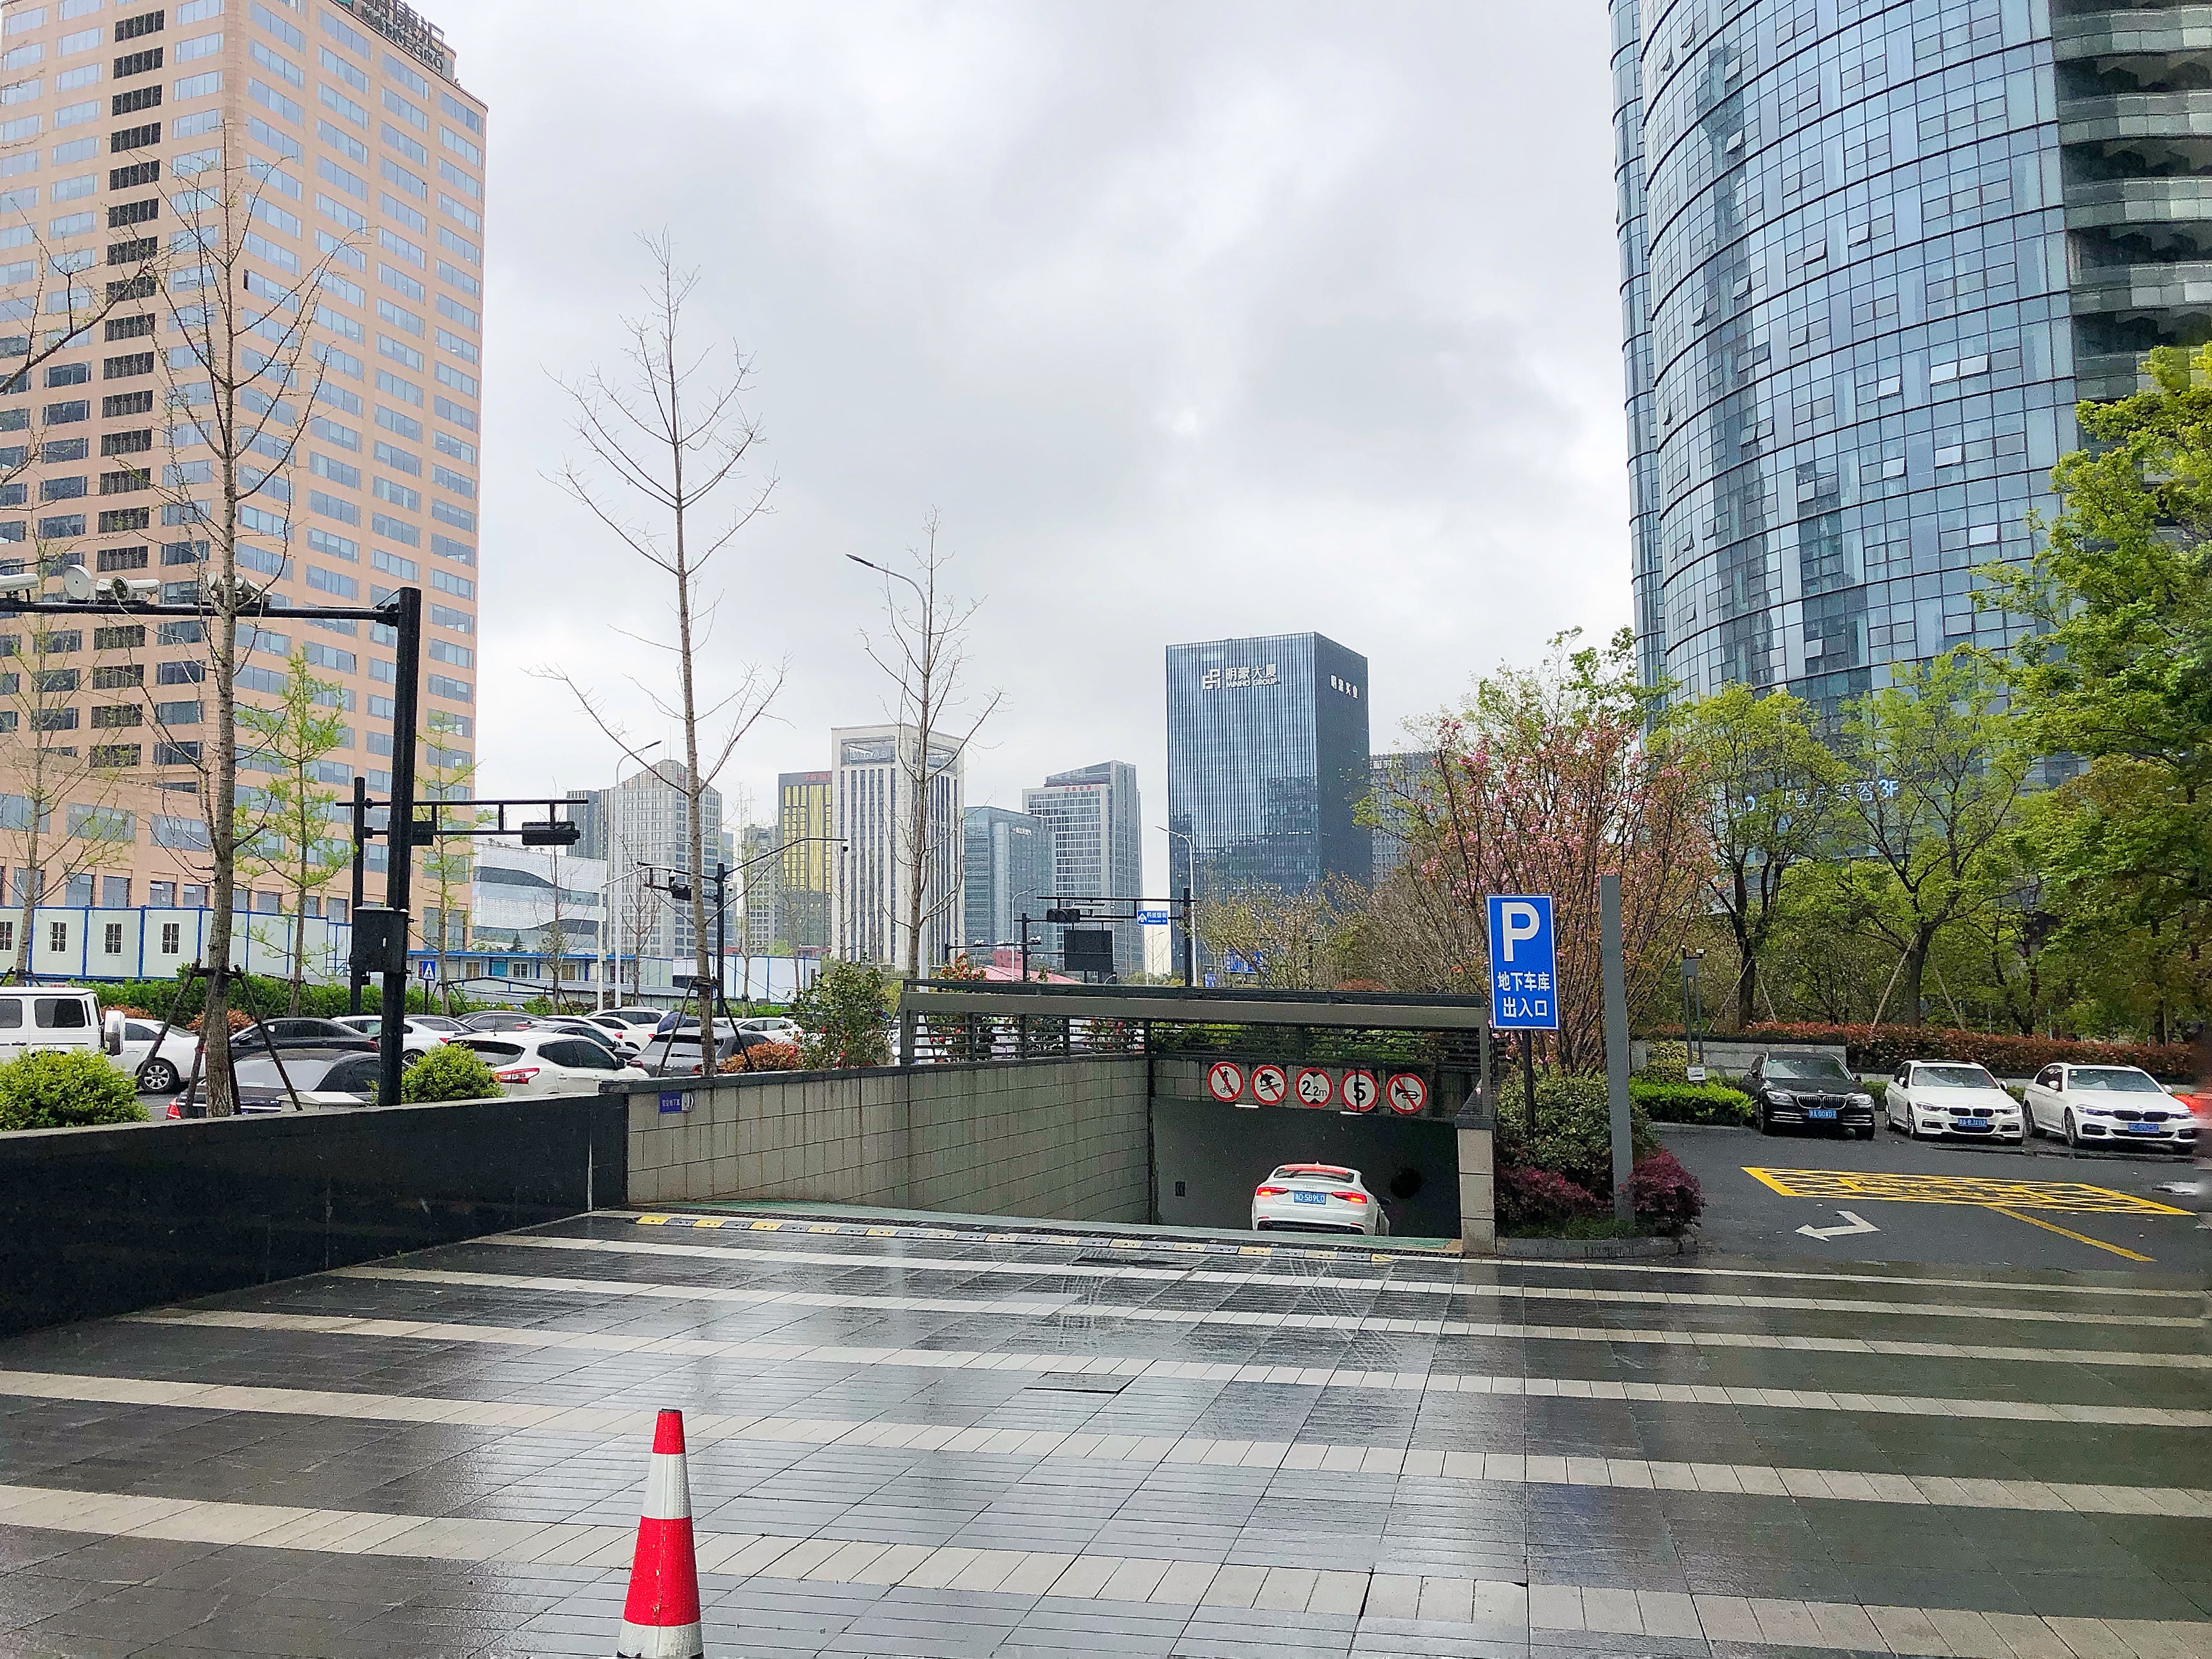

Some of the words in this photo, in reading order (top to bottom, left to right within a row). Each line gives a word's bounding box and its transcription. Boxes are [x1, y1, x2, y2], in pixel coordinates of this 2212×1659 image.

[1225, 663, 1277, 681] 明豪大厦
[1226, 680, 1251, 689] MINHO
[1252, 678, 1278, 686] GROUP
[1501, 902, 1540, 962] P
[1497, 971, 1551, 992] 地下车库
[1503, 996, 1548, 1018] 出入口
[1301, 1080, 1328, 1097] 2.2m
[1353, 1082, 1366, 1102] 5
